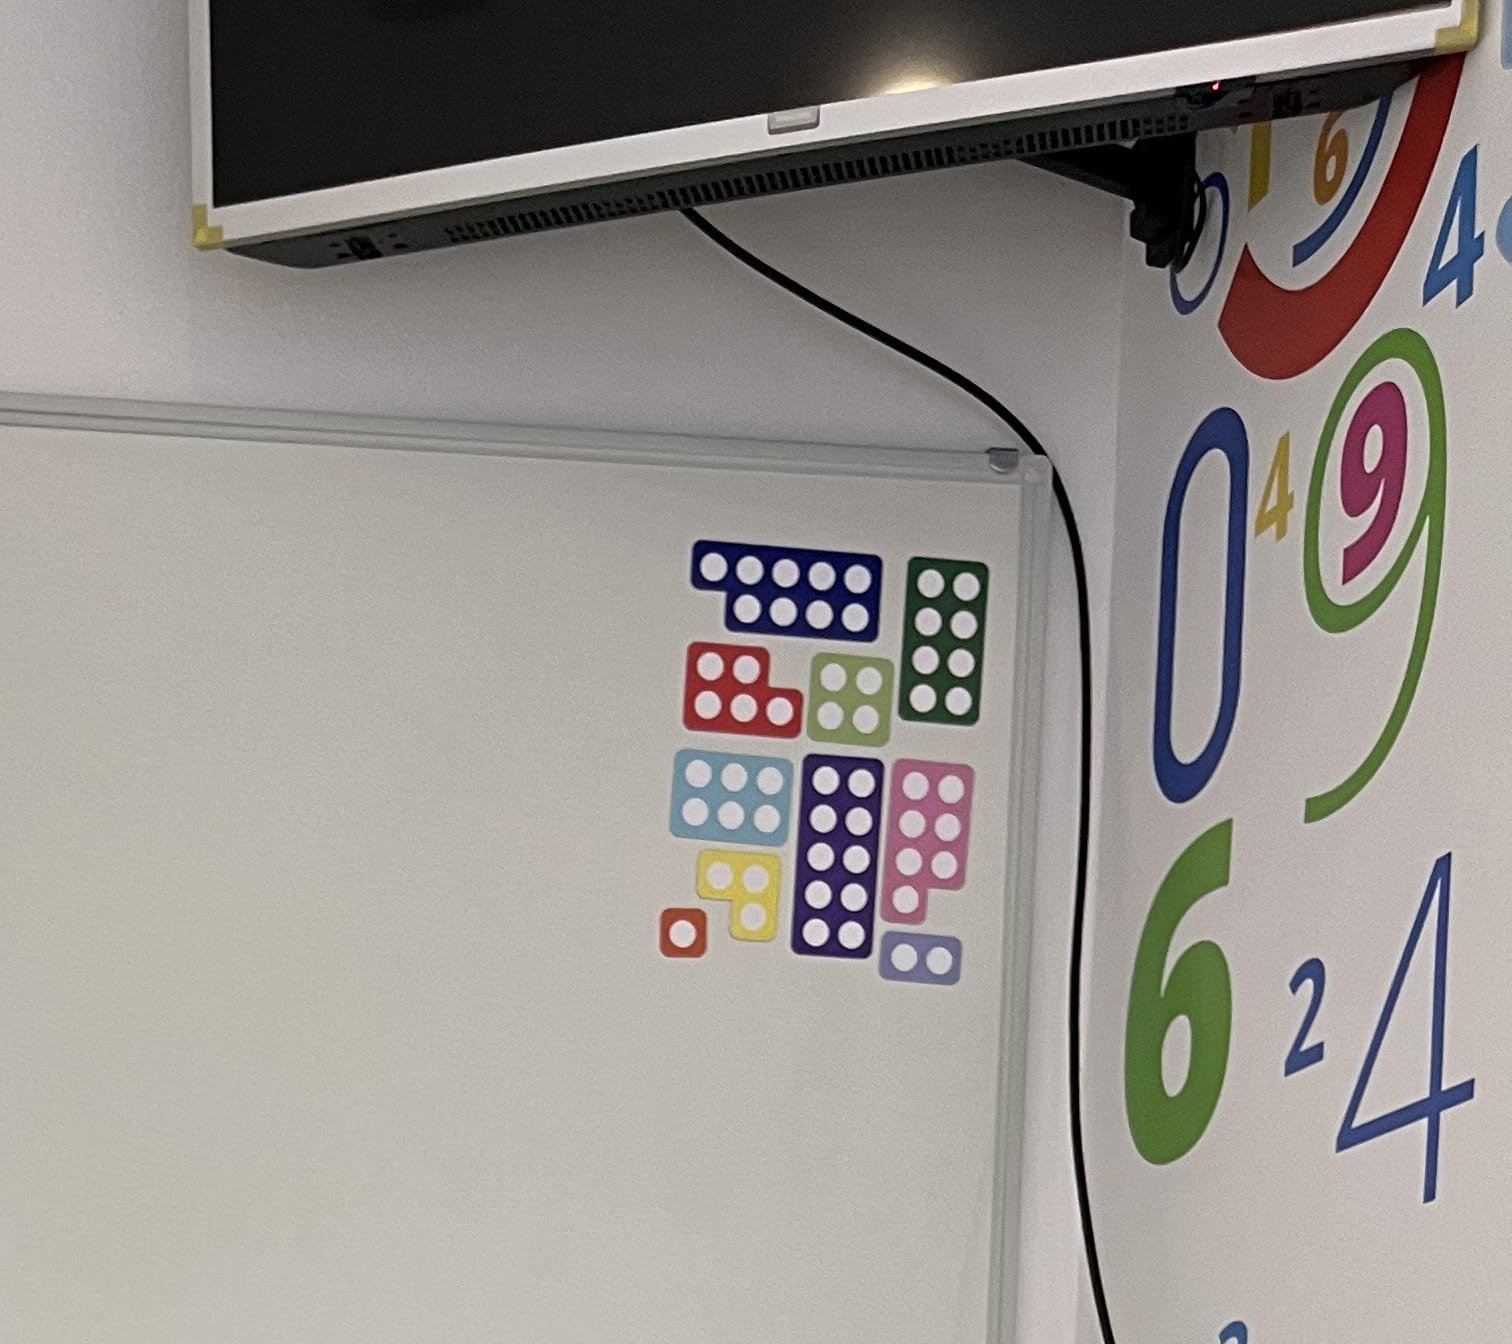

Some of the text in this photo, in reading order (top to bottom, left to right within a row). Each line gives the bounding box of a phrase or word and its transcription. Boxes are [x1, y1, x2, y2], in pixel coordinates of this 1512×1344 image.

[1314, 109, 1349, 206] 6
[1422, 143, 1485, 309] 4
[1254, 430, 1295, 543] 4
[1303, 327, 1448, 824] 9
[1339, 381, 1408, 586] 9
[1153, 406, 1250, 804] 0
[1124, 817, 1234, 1166] 6
[1284, 957, 1326, 1078] 2
[1335, 851, 1476, 1204] 4
